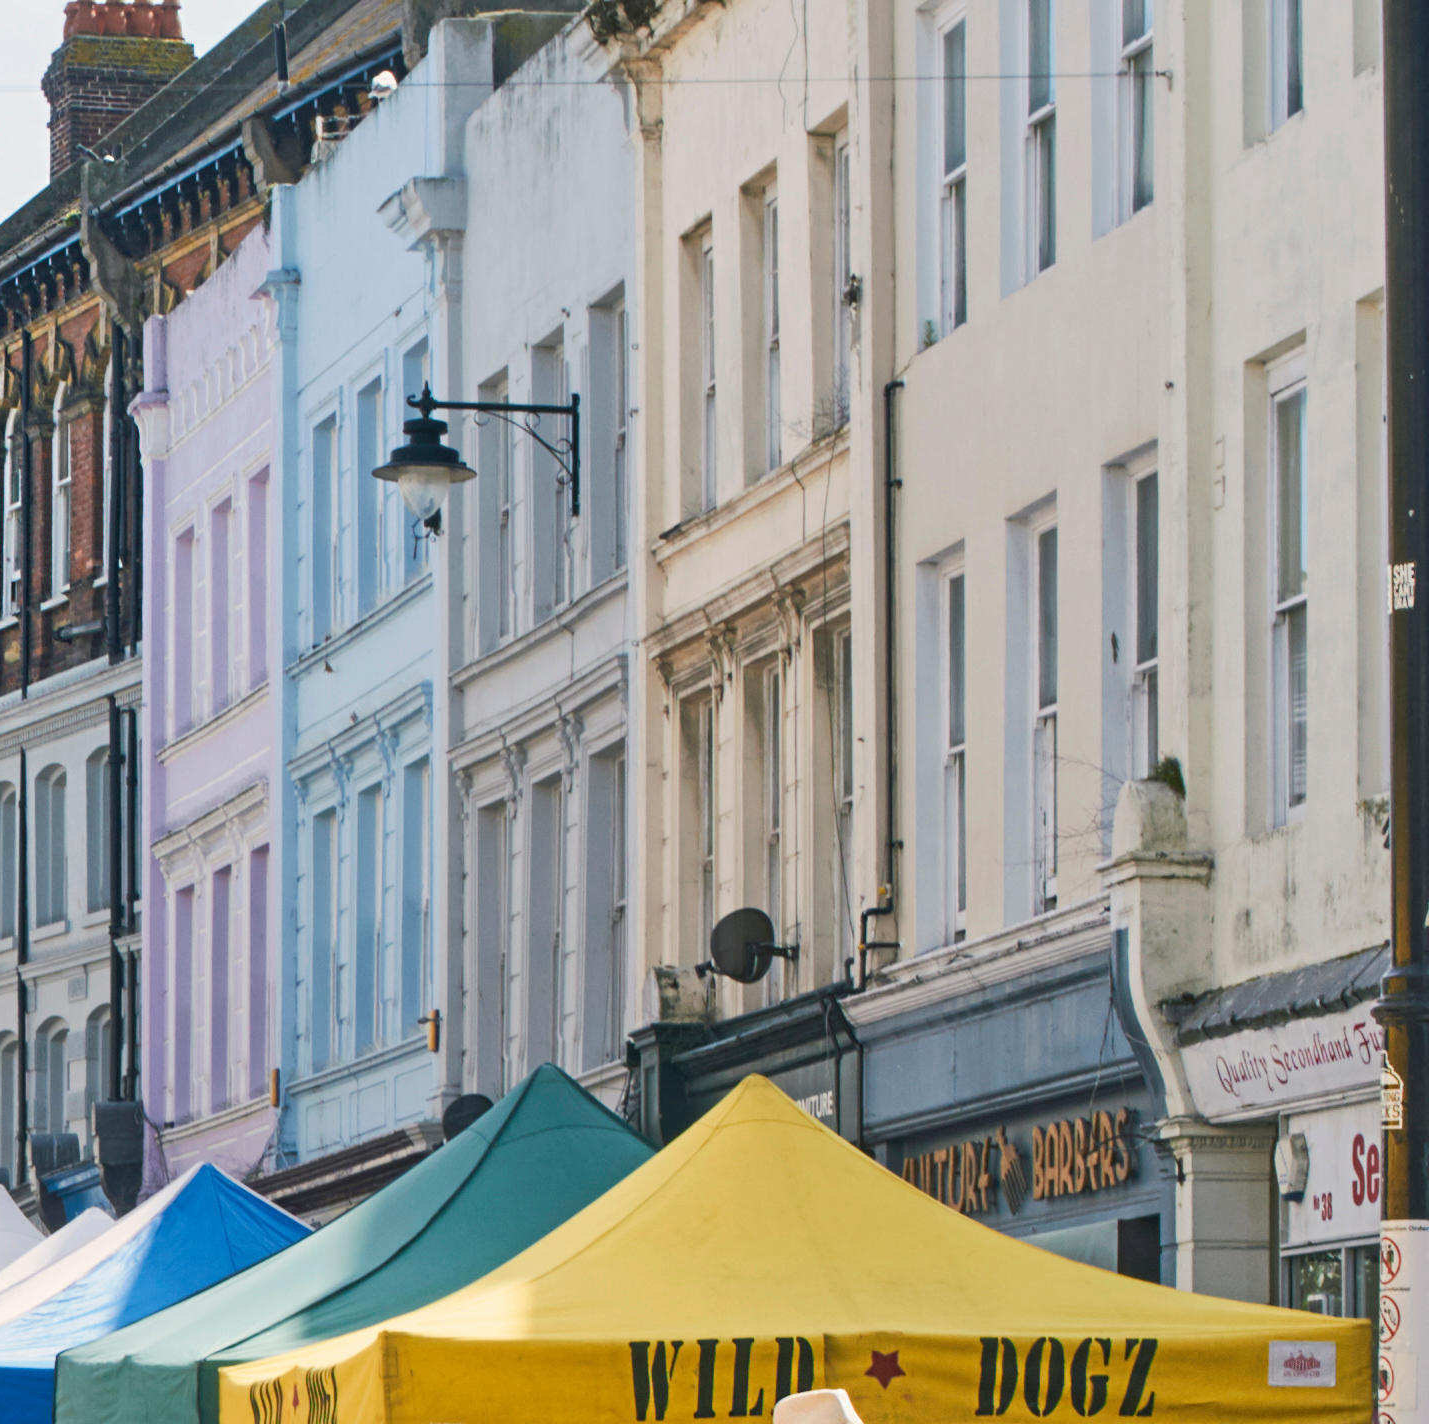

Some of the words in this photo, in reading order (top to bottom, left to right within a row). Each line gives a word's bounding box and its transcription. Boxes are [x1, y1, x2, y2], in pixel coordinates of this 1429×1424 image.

[1216, 1050, 1274, 1097] Quality
[1270, 1027, 1354, 1084] Secondhand
[1321, 1192, 1333, 1221] 38
[629, 1336, 814, 1421] WILD
[975, 1336, 1159, 1418] DOGZ
